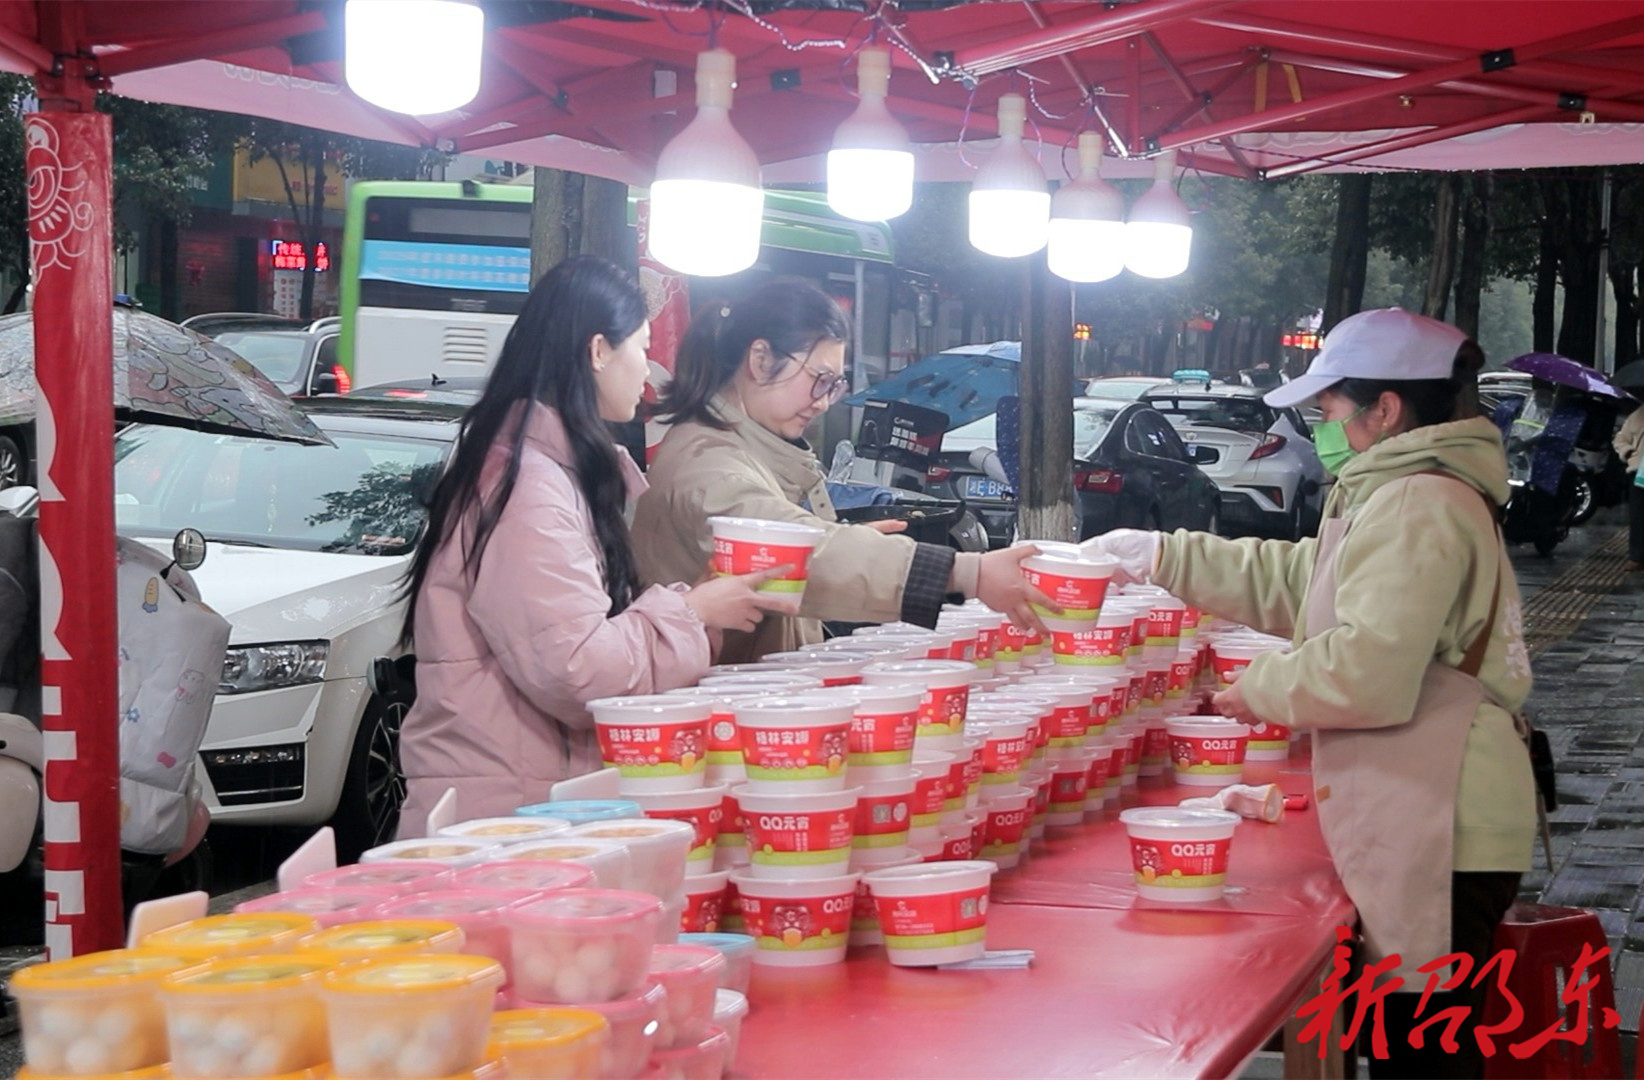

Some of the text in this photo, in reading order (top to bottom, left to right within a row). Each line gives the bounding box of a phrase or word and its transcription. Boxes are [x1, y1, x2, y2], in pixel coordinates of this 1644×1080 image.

[1202, 740, 1238, 750] QQ元宵
[760, 816, 809, 831] QQ元宵
[1171, 843, 1216, 856] QQ元宵
